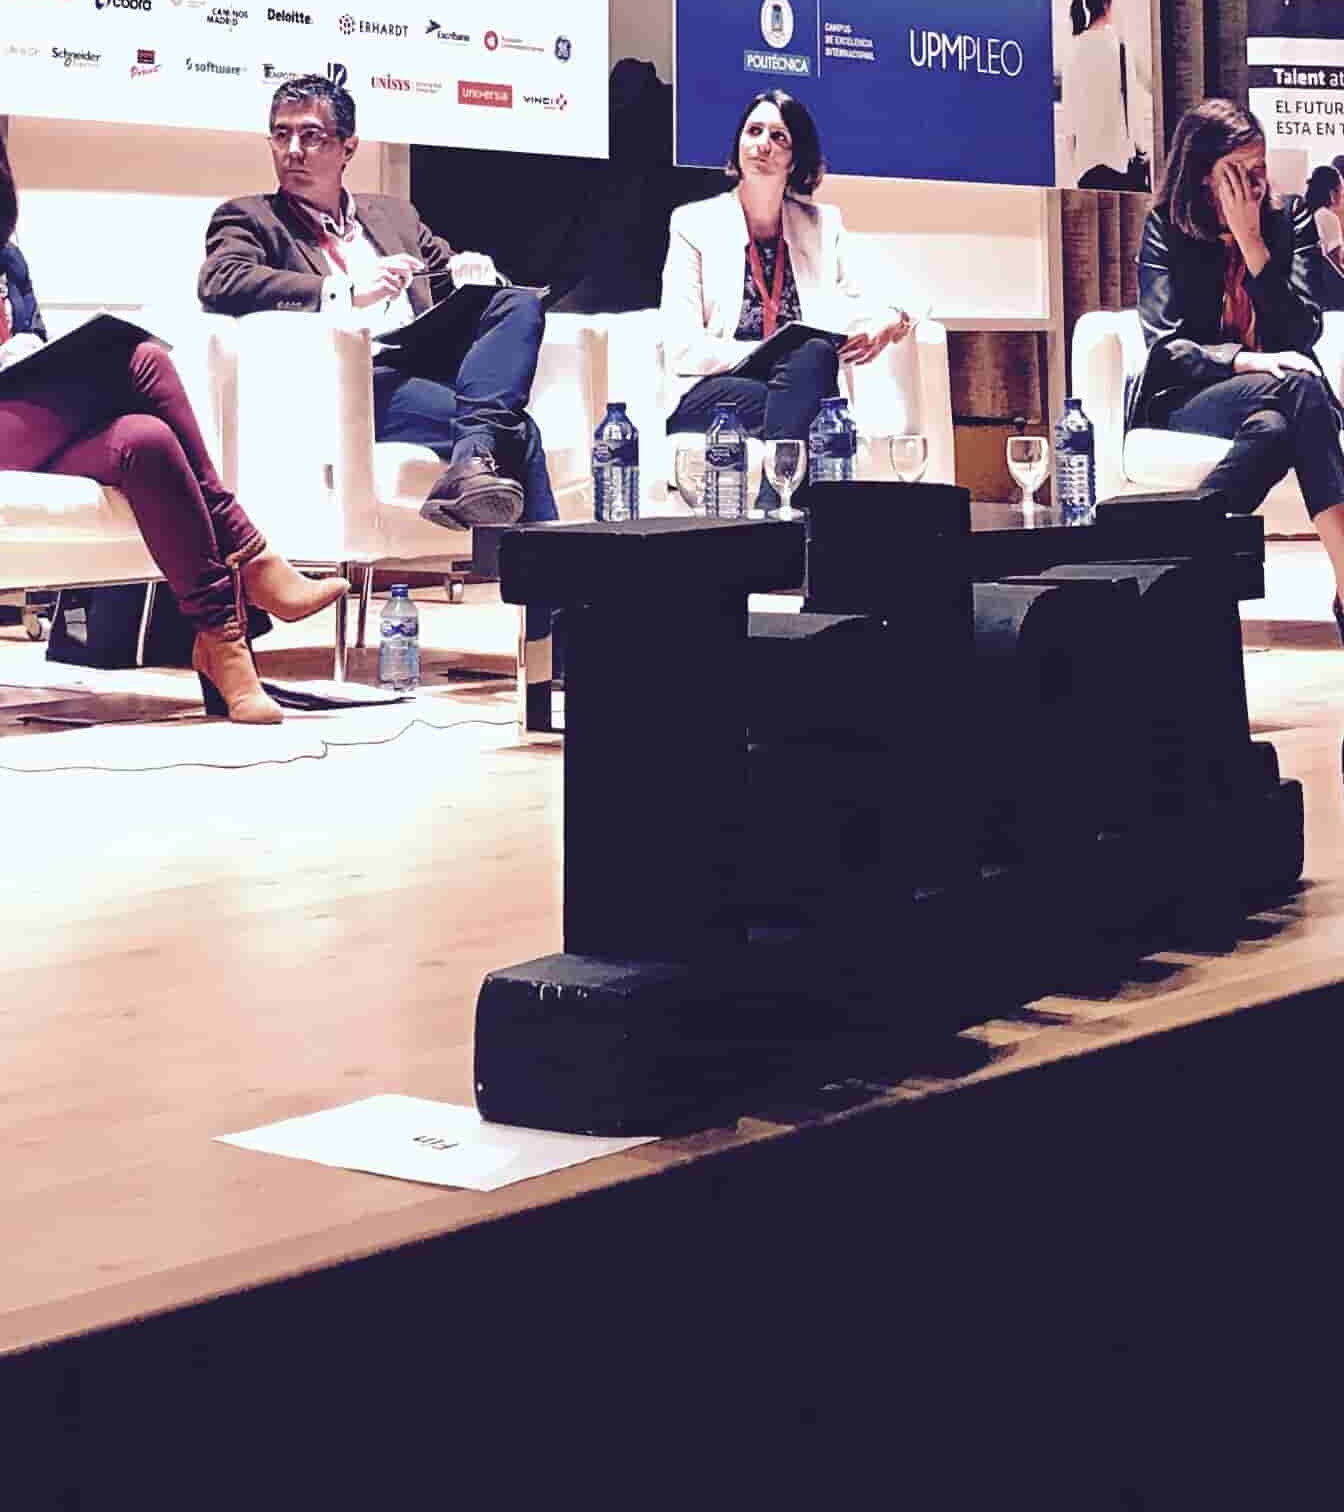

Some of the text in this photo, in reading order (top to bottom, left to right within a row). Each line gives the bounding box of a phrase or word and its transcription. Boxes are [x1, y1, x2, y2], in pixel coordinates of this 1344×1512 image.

[359, 20, 409, 38] ERHARDT
[909, 29, 1024, 78] UPMPLEO
[1272, 67, 1327, 86] Talent
[1276, 99, 1292, 114] EL
[1276, 120, 1312, 136] ESTA
[1316, 122, 1336, 137] EN
